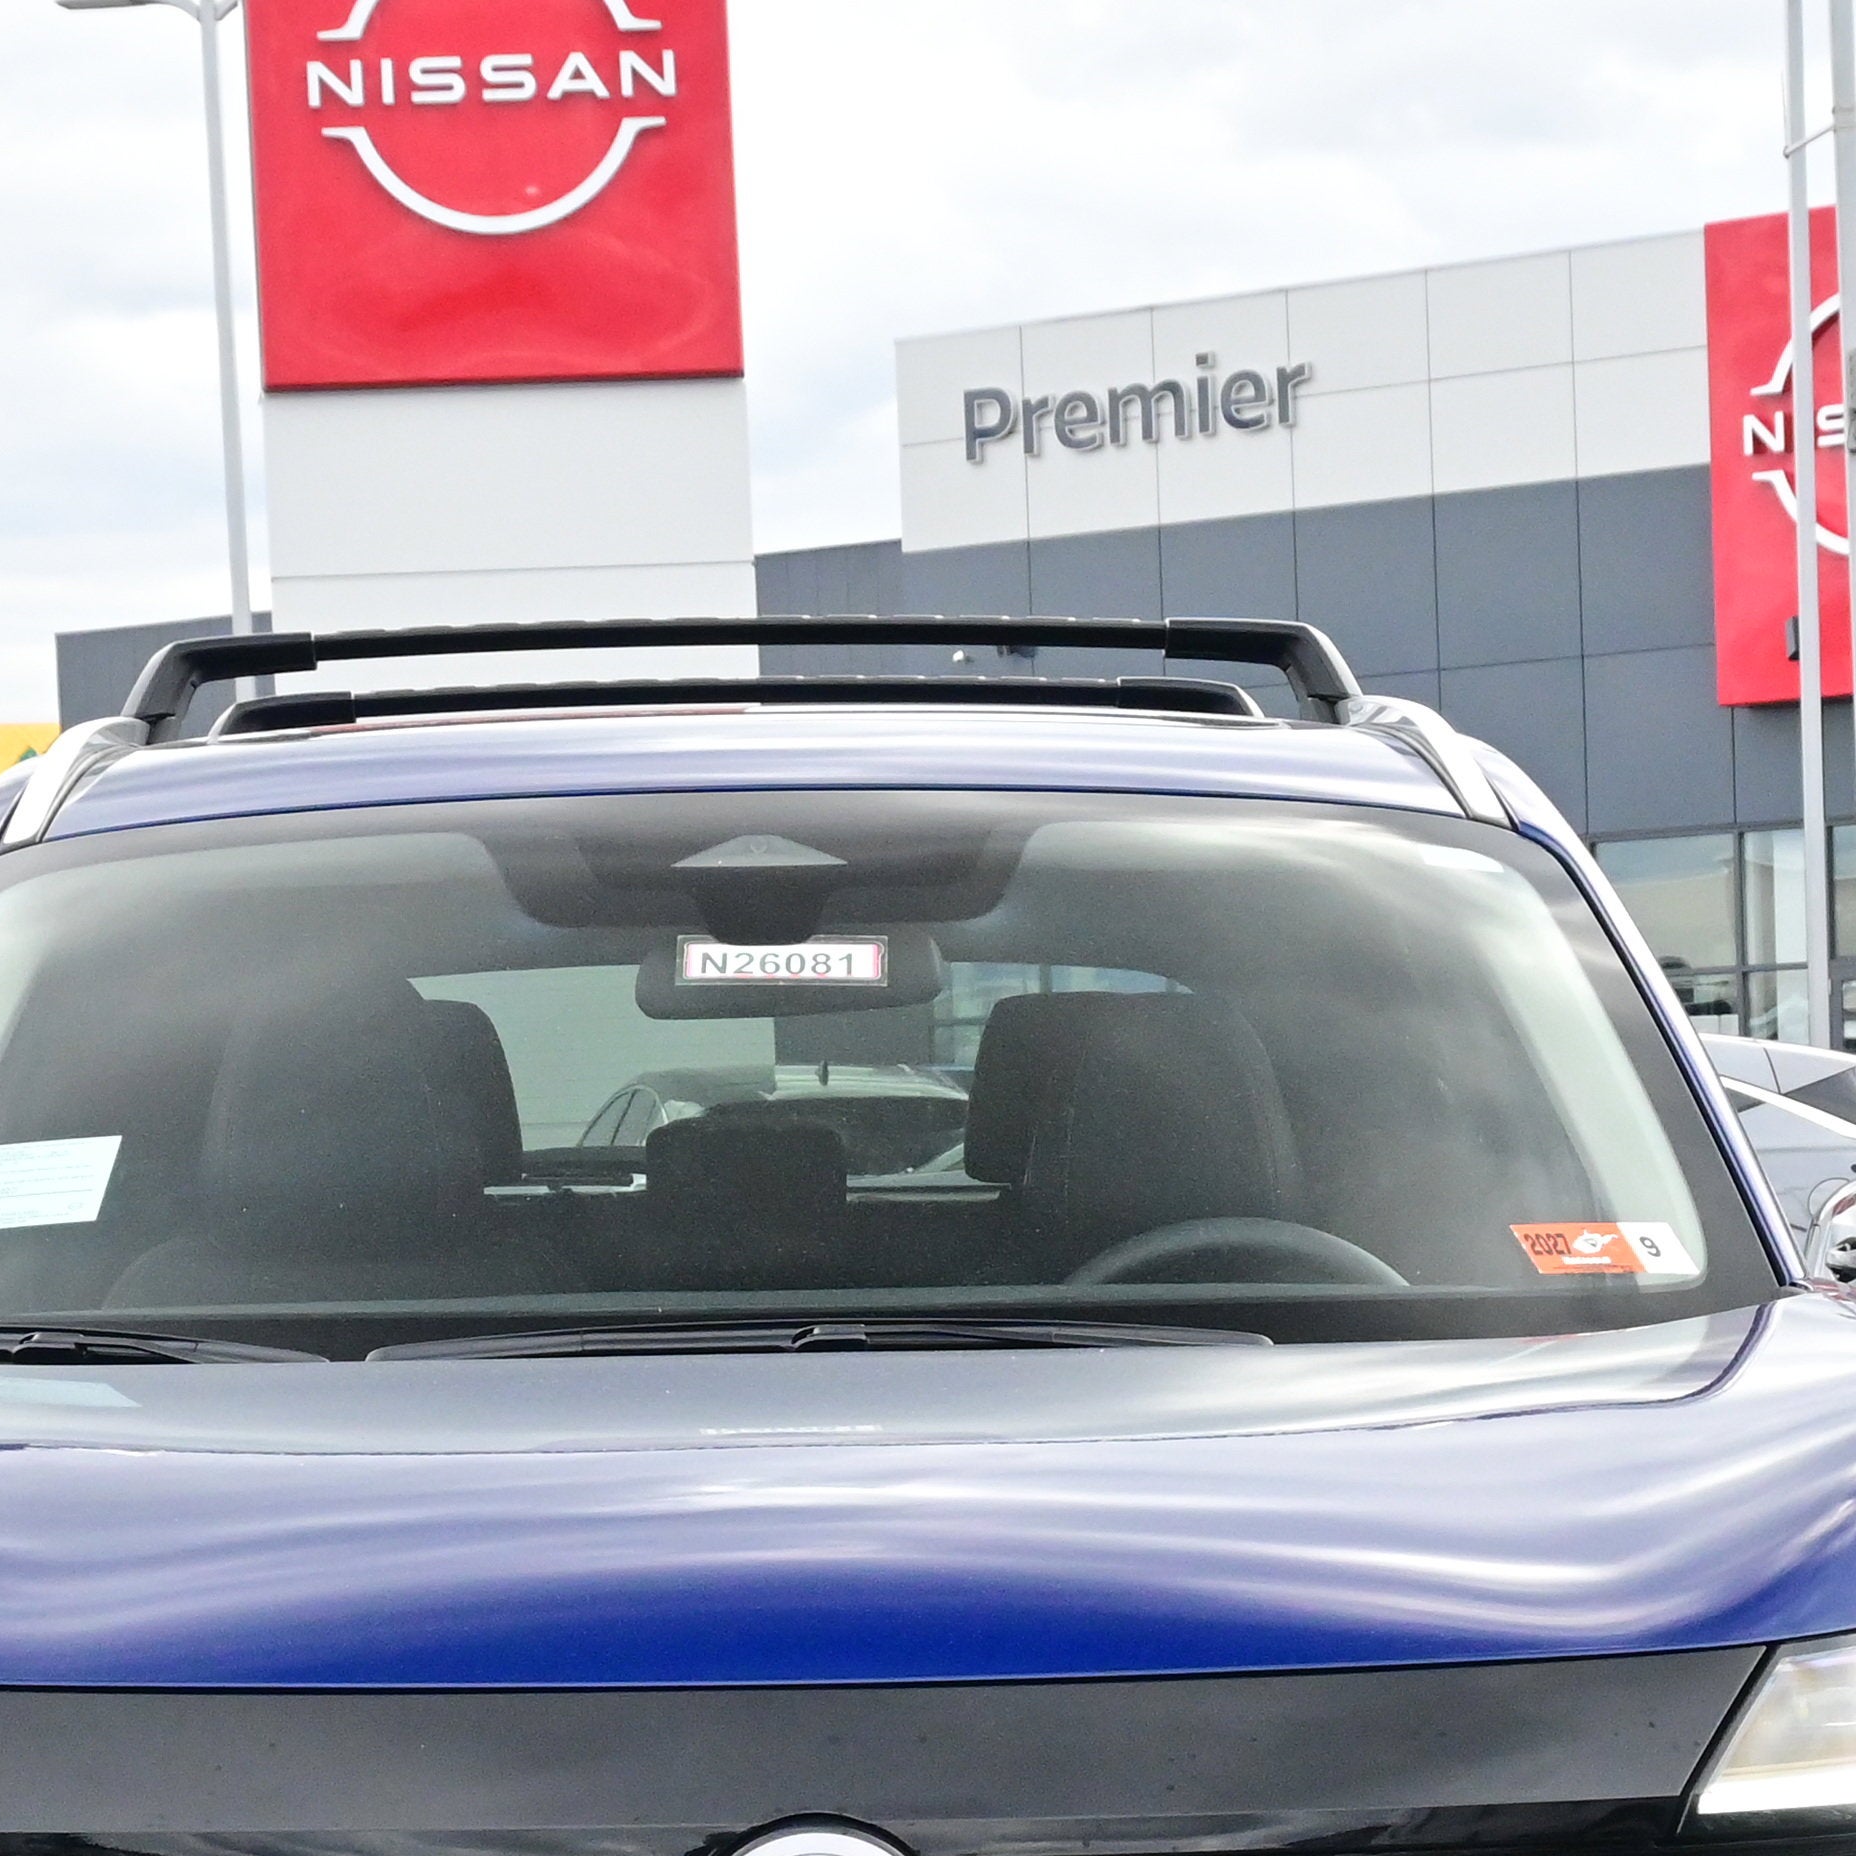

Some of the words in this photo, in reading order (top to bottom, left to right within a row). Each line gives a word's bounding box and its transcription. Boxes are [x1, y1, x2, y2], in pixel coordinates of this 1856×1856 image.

[306, 48, 677, 109] NISSAN
[964, 351, 1311, 463] Premier
[701, 952, 854, 976] N26081
[1523, 1232, 1573, 1256] 2027
[1639, 1236, 1661, 1257] 9
